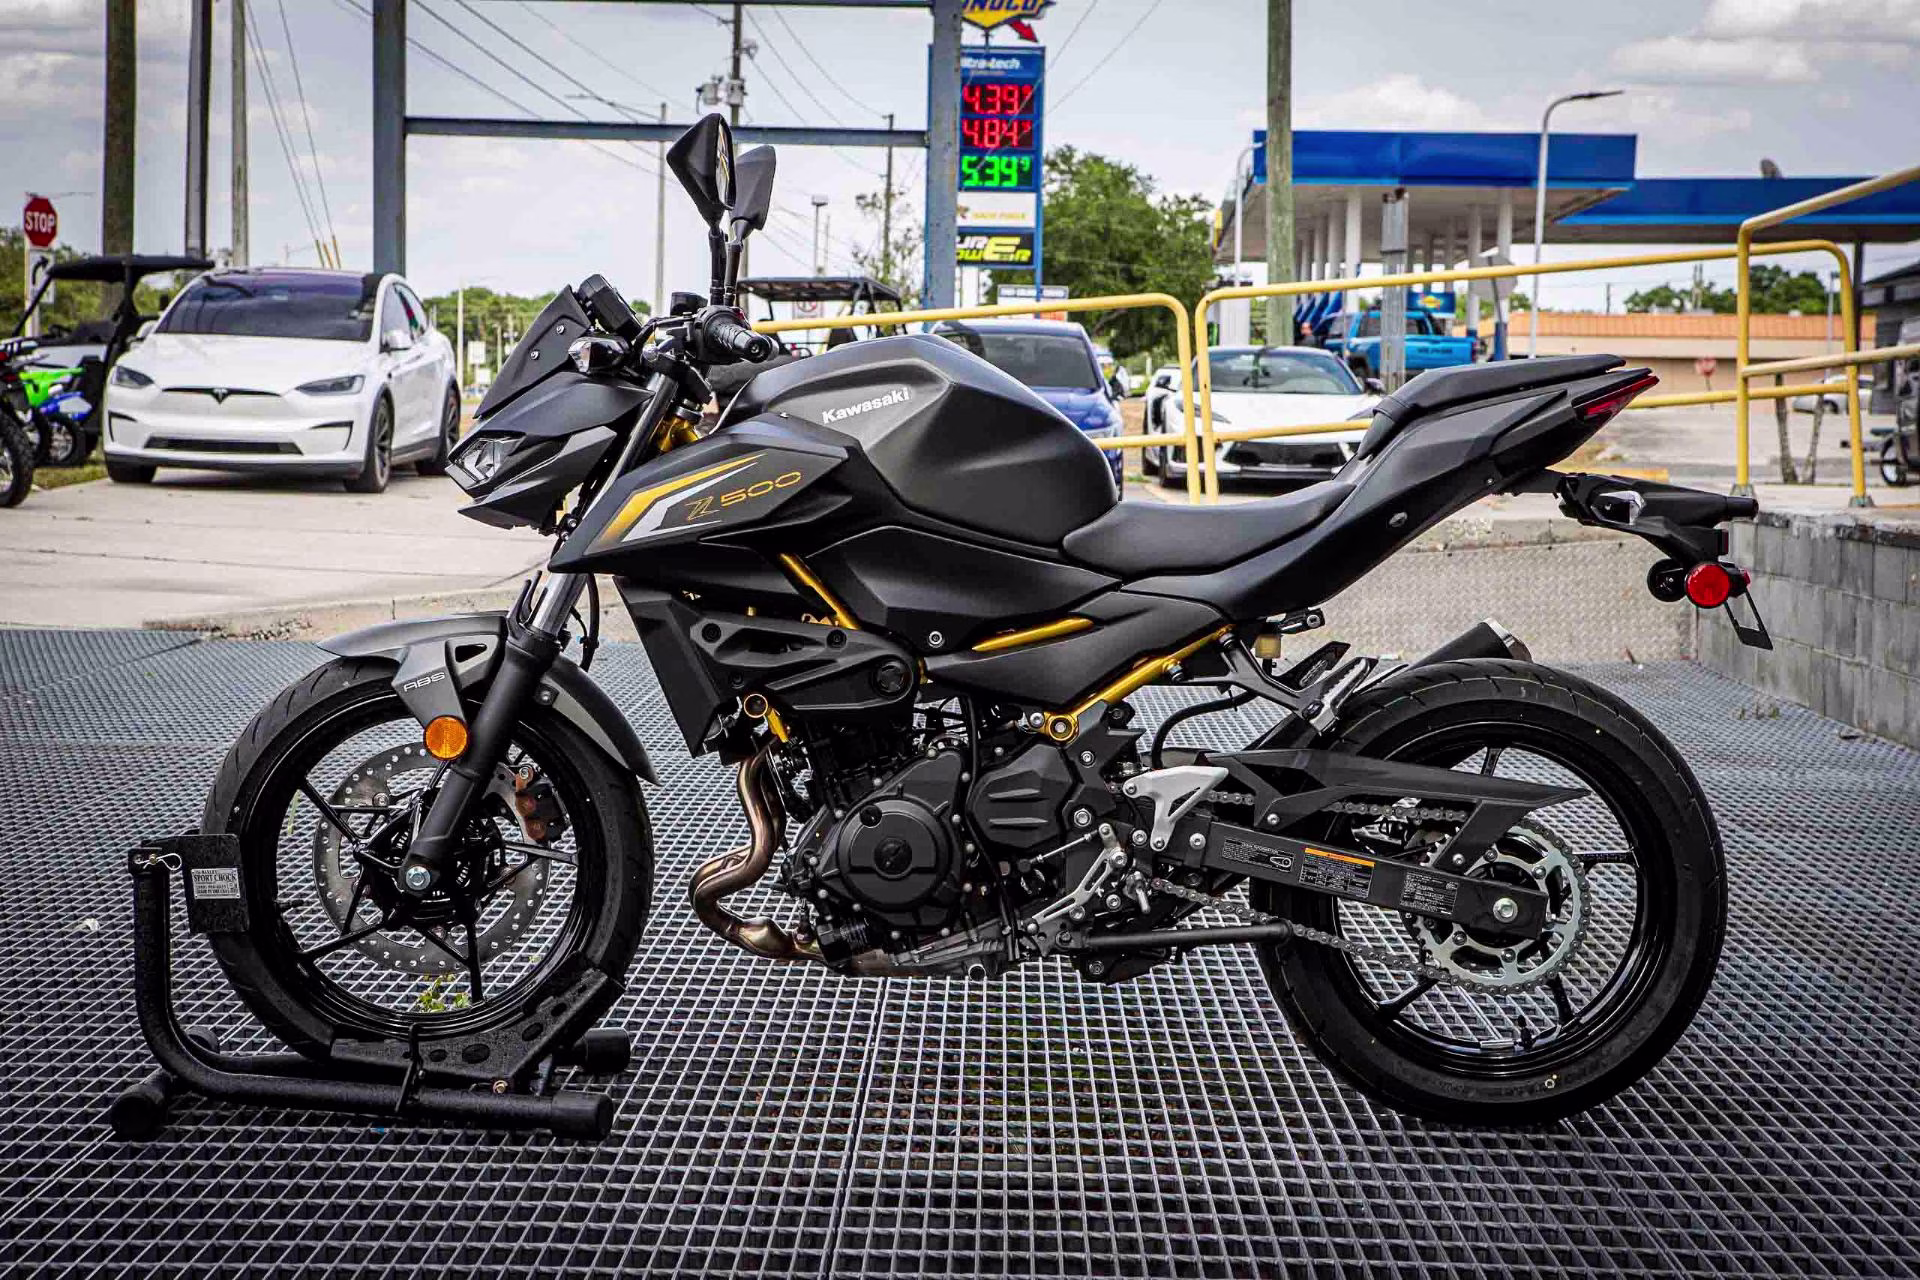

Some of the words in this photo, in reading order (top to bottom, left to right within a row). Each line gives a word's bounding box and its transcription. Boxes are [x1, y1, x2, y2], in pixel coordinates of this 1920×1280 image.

[25, 211, 55, 233] STOP
[822, 387, 909, 424] Kawasaki
[403, 672, 446, 692] ABS
